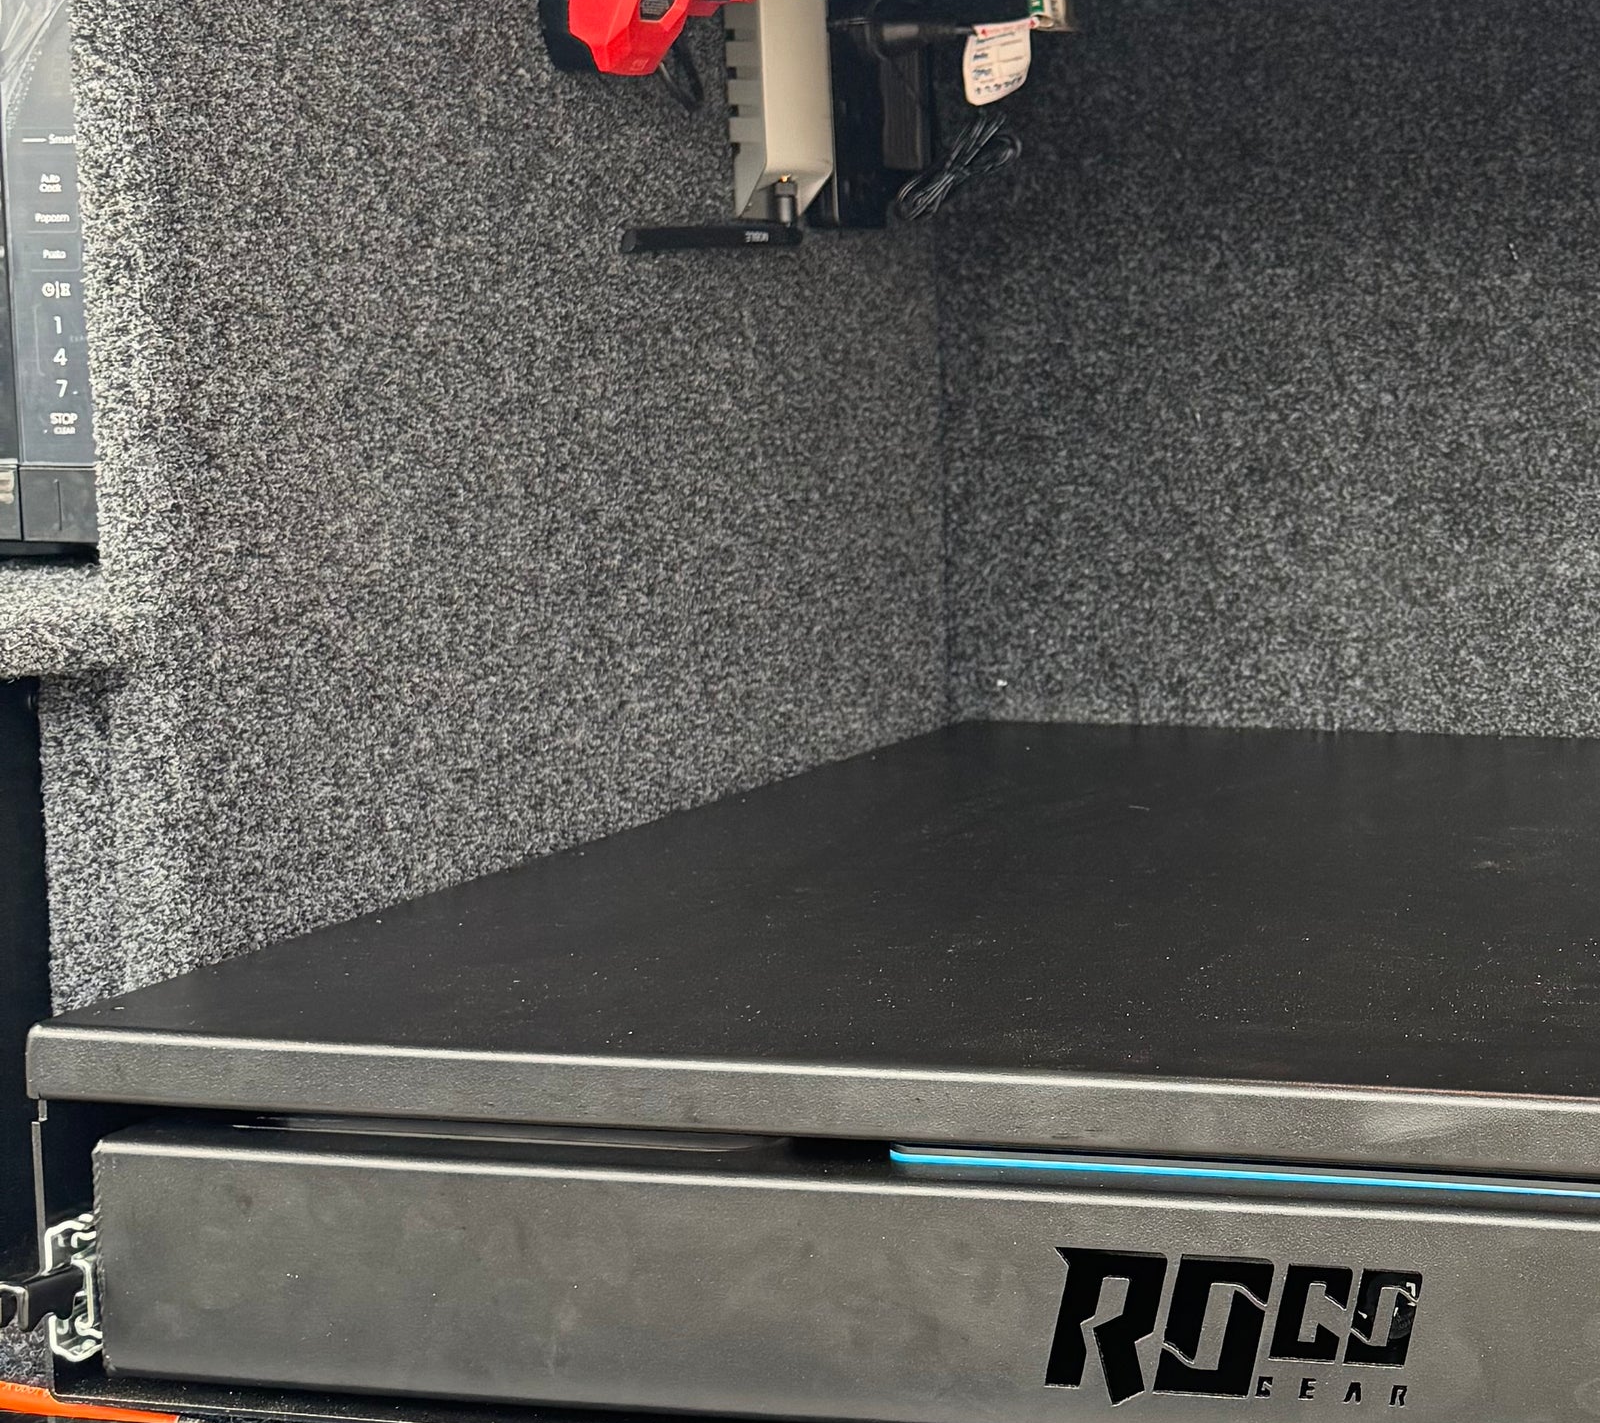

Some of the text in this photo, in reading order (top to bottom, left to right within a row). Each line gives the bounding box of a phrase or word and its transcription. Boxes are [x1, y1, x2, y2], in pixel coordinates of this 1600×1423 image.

[53, 316, 62, 335] 1
[53, 348, 68, 366] 4
[56, 379, 68, 398] 7
[49, 412, 78, 426] STOP
[1254, 1375, 1409, 1408] GEAR
